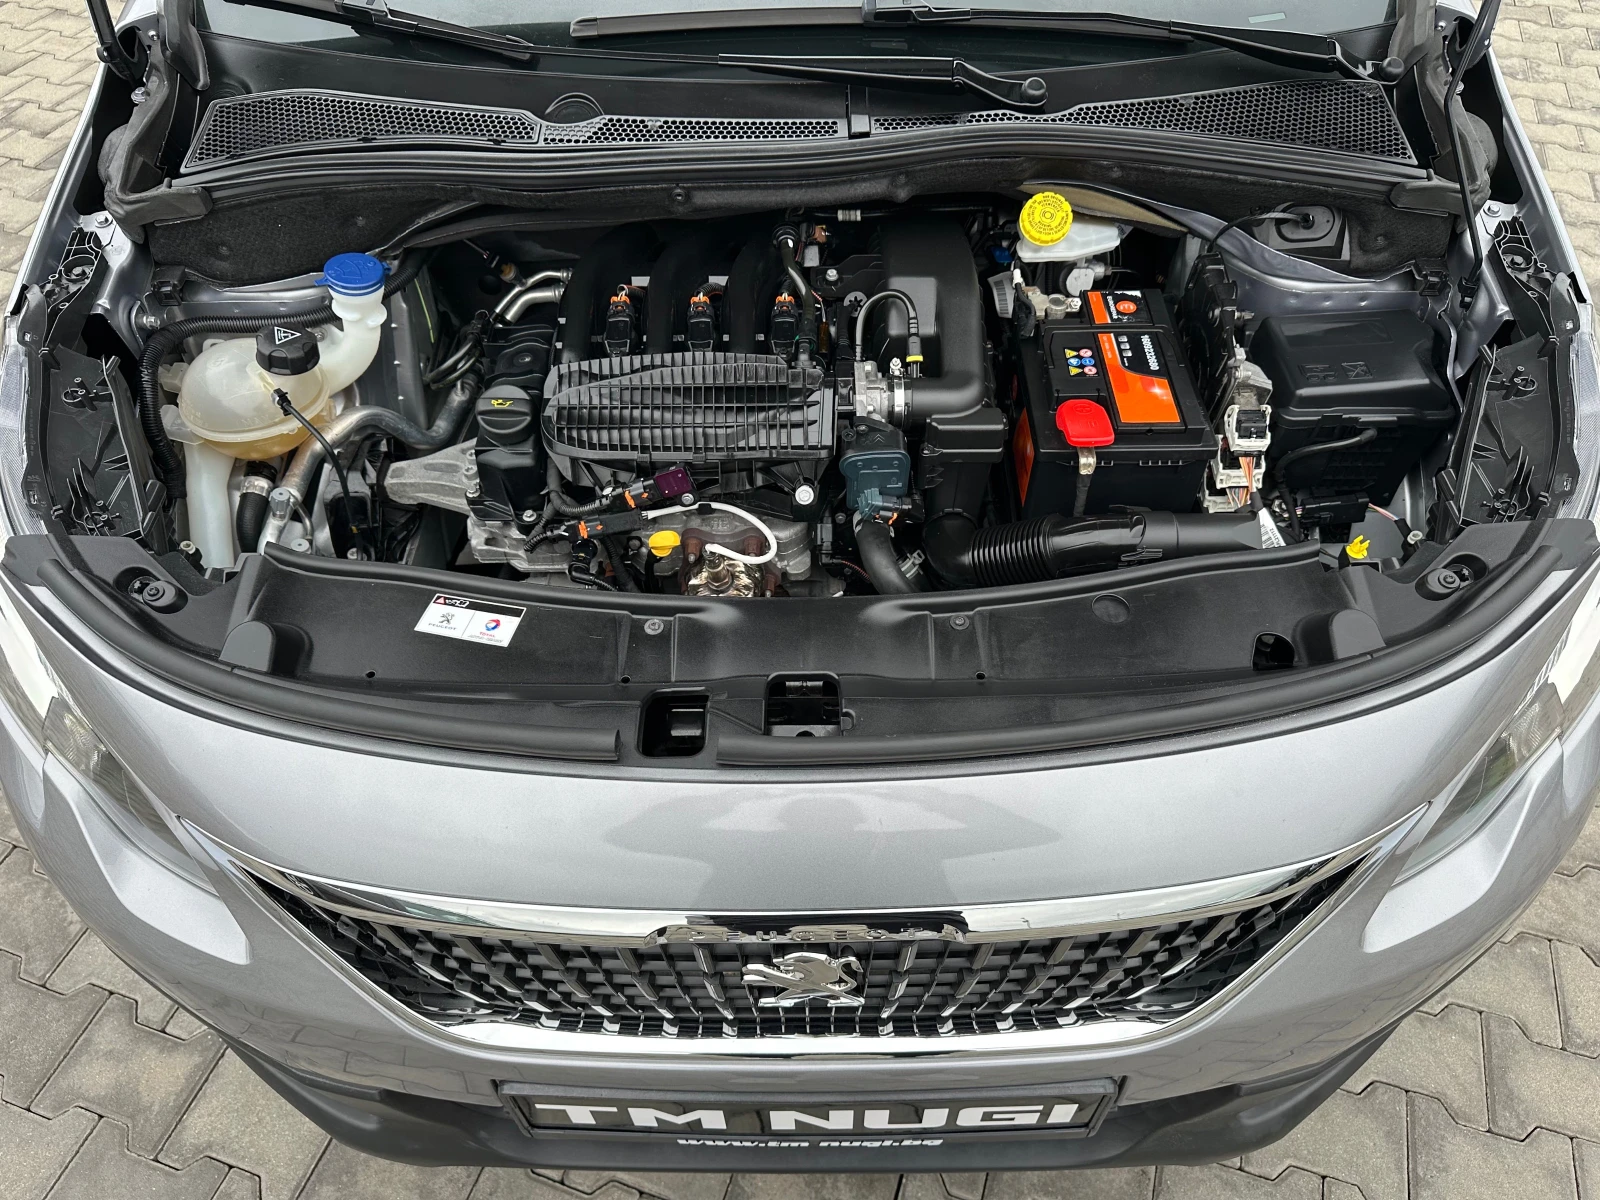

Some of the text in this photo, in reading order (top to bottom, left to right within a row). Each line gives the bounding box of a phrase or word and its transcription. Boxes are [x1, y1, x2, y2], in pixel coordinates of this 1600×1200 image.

[428, 623, 457, 631] PEUGEOT
[535, 1103, 1079, 1130] TM NUGI
